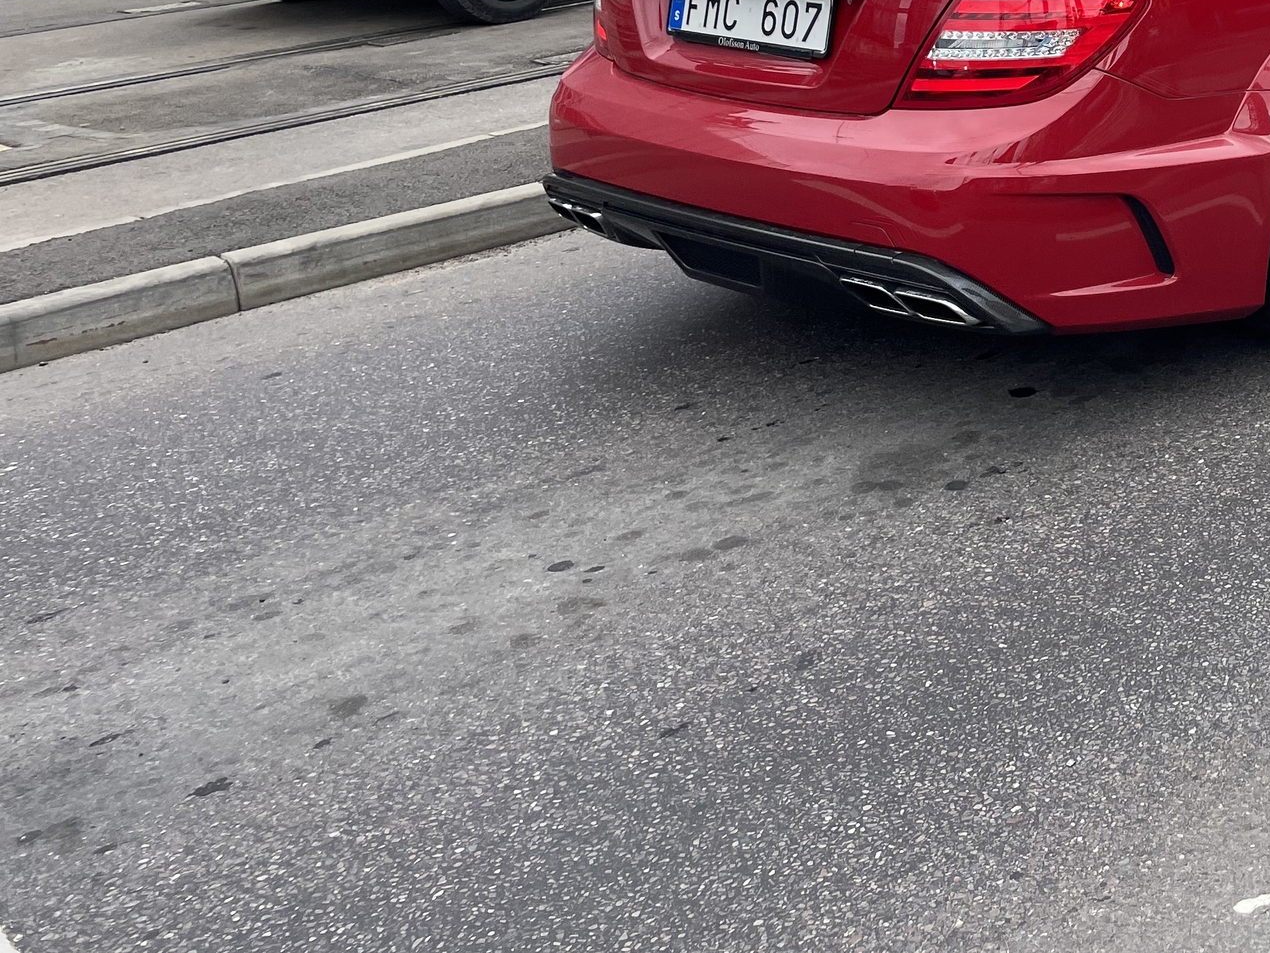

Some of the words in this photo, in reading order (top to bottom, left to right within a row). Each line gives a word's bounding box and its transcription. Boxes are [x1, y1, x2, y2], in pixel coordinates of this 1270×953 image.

[674, 10, 680, 21] S
[717, 36, 745, 49] Olofsson
[745, 42, 760, 52] Auto
